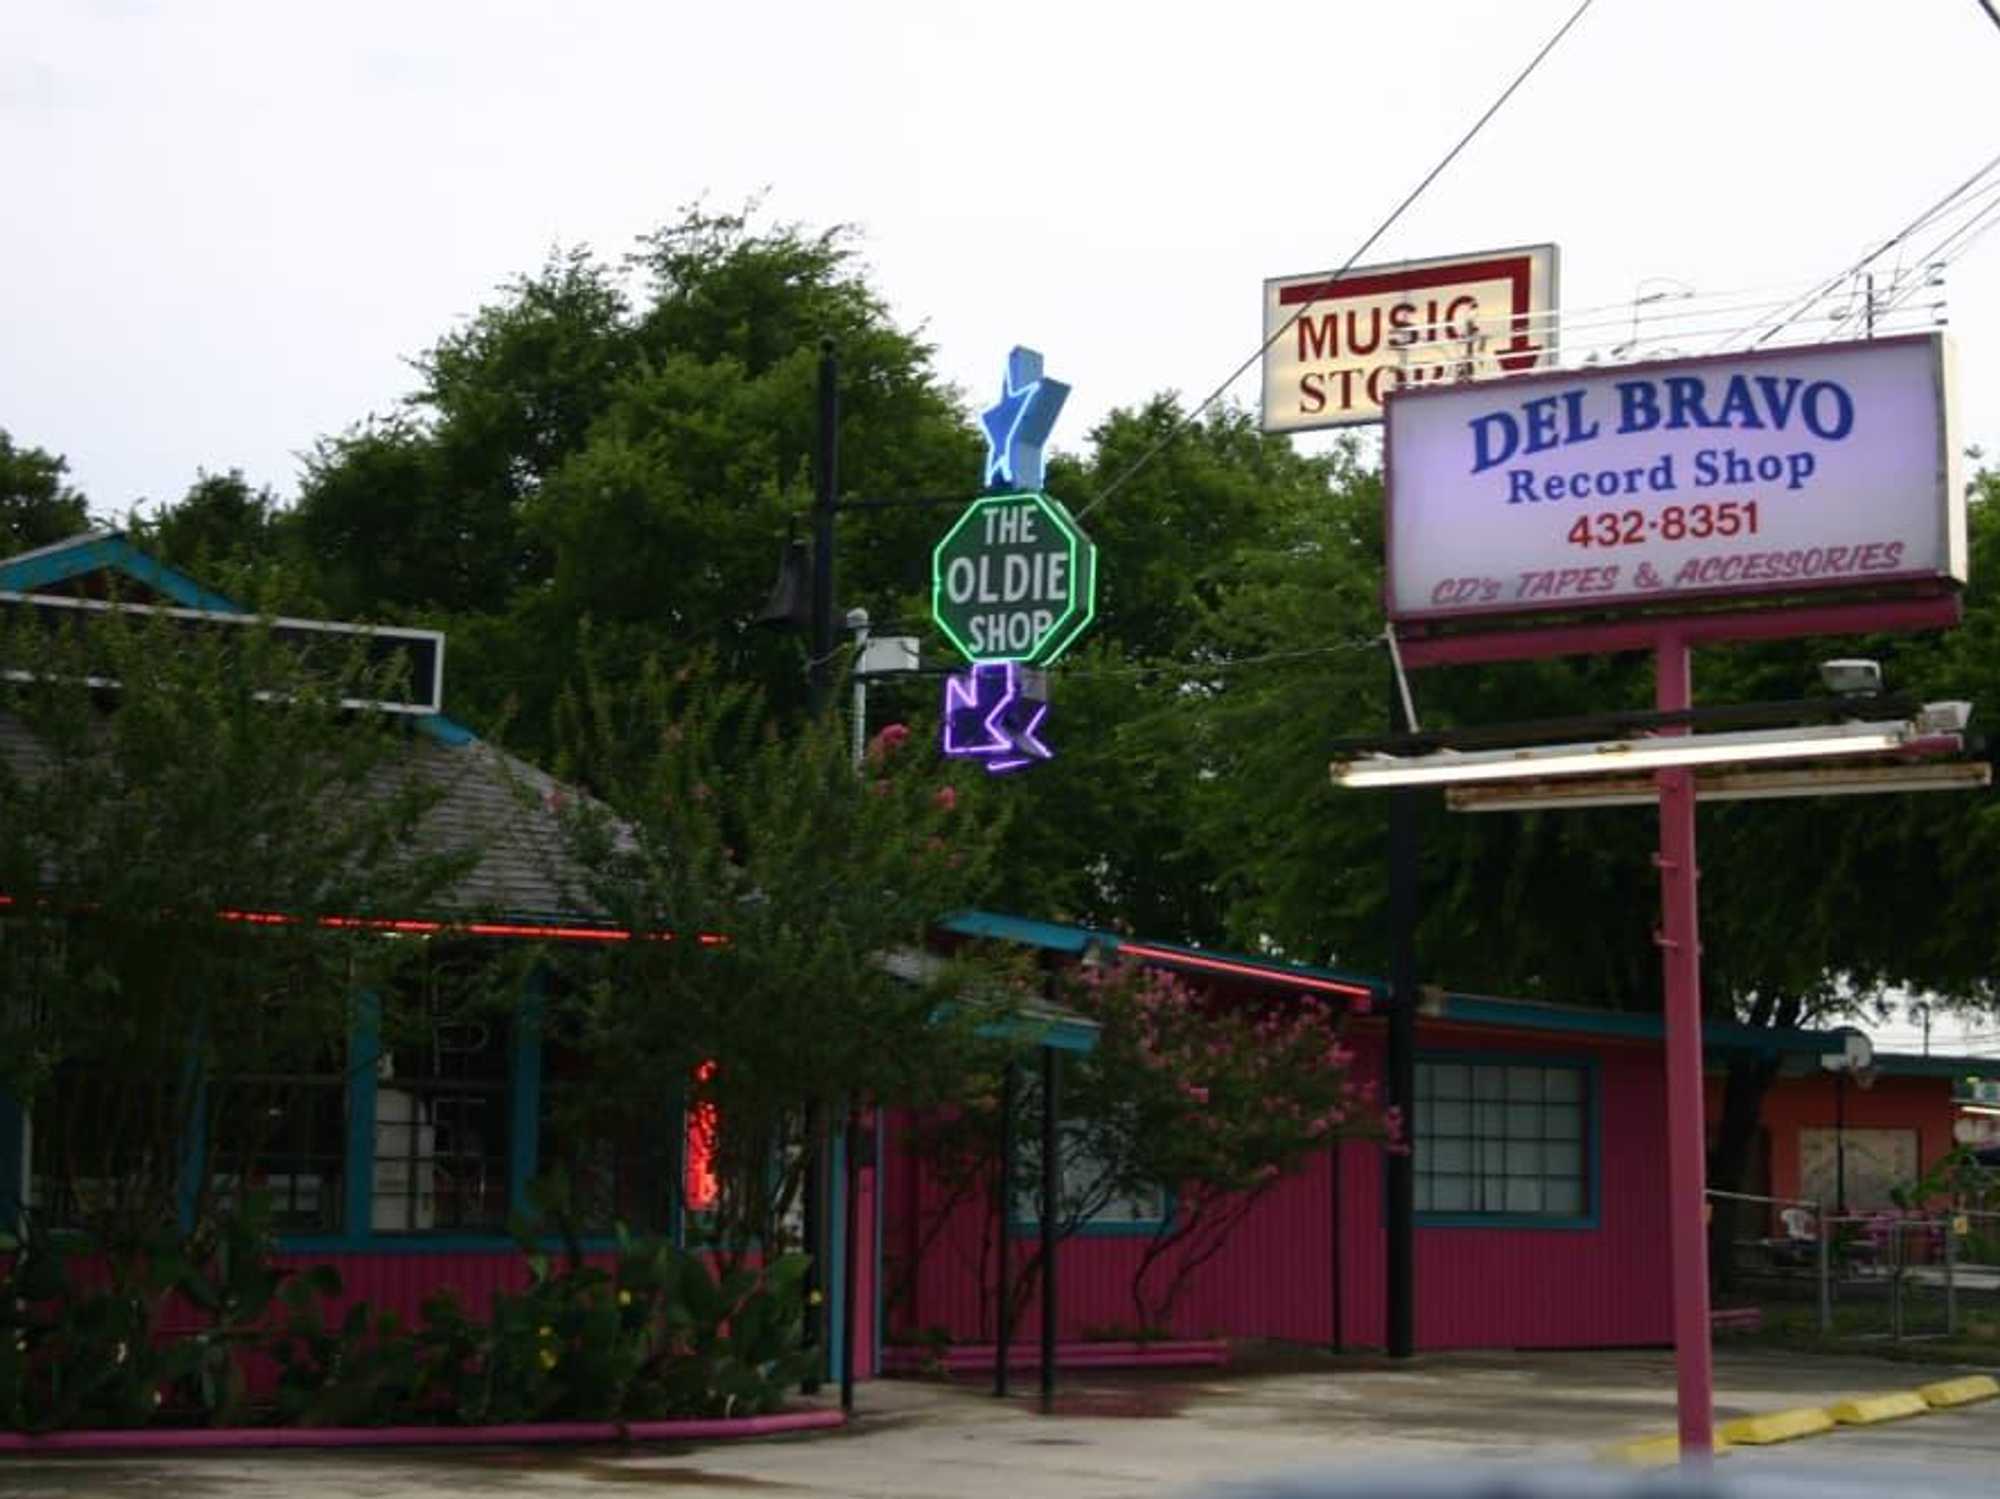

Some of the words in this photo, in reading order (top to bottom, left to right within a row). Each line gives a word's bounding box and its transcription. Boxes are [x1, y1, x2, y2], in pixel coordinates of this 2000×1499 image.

[1298, 296, 1478, 362] MUSIC
[1468, 389, 1599, 475] DEL
[1615, 375, 1855, 441] BRAVO
[1509, 455, 1676, 504] Record
[1694, 447, 1815, 489] Shop
[982, 504, 1039, 545] THE
[947, 552, 1068, 605] OLDIE
[1431, 578, 1503, 604] CD's
[1517, 565, 1620, 598] TAPES
[1633, 561, 1663, 589] &
[1675, 541, 1905, 586] ACCESSORIES
[968, 609, 1053, 653] SHOP
